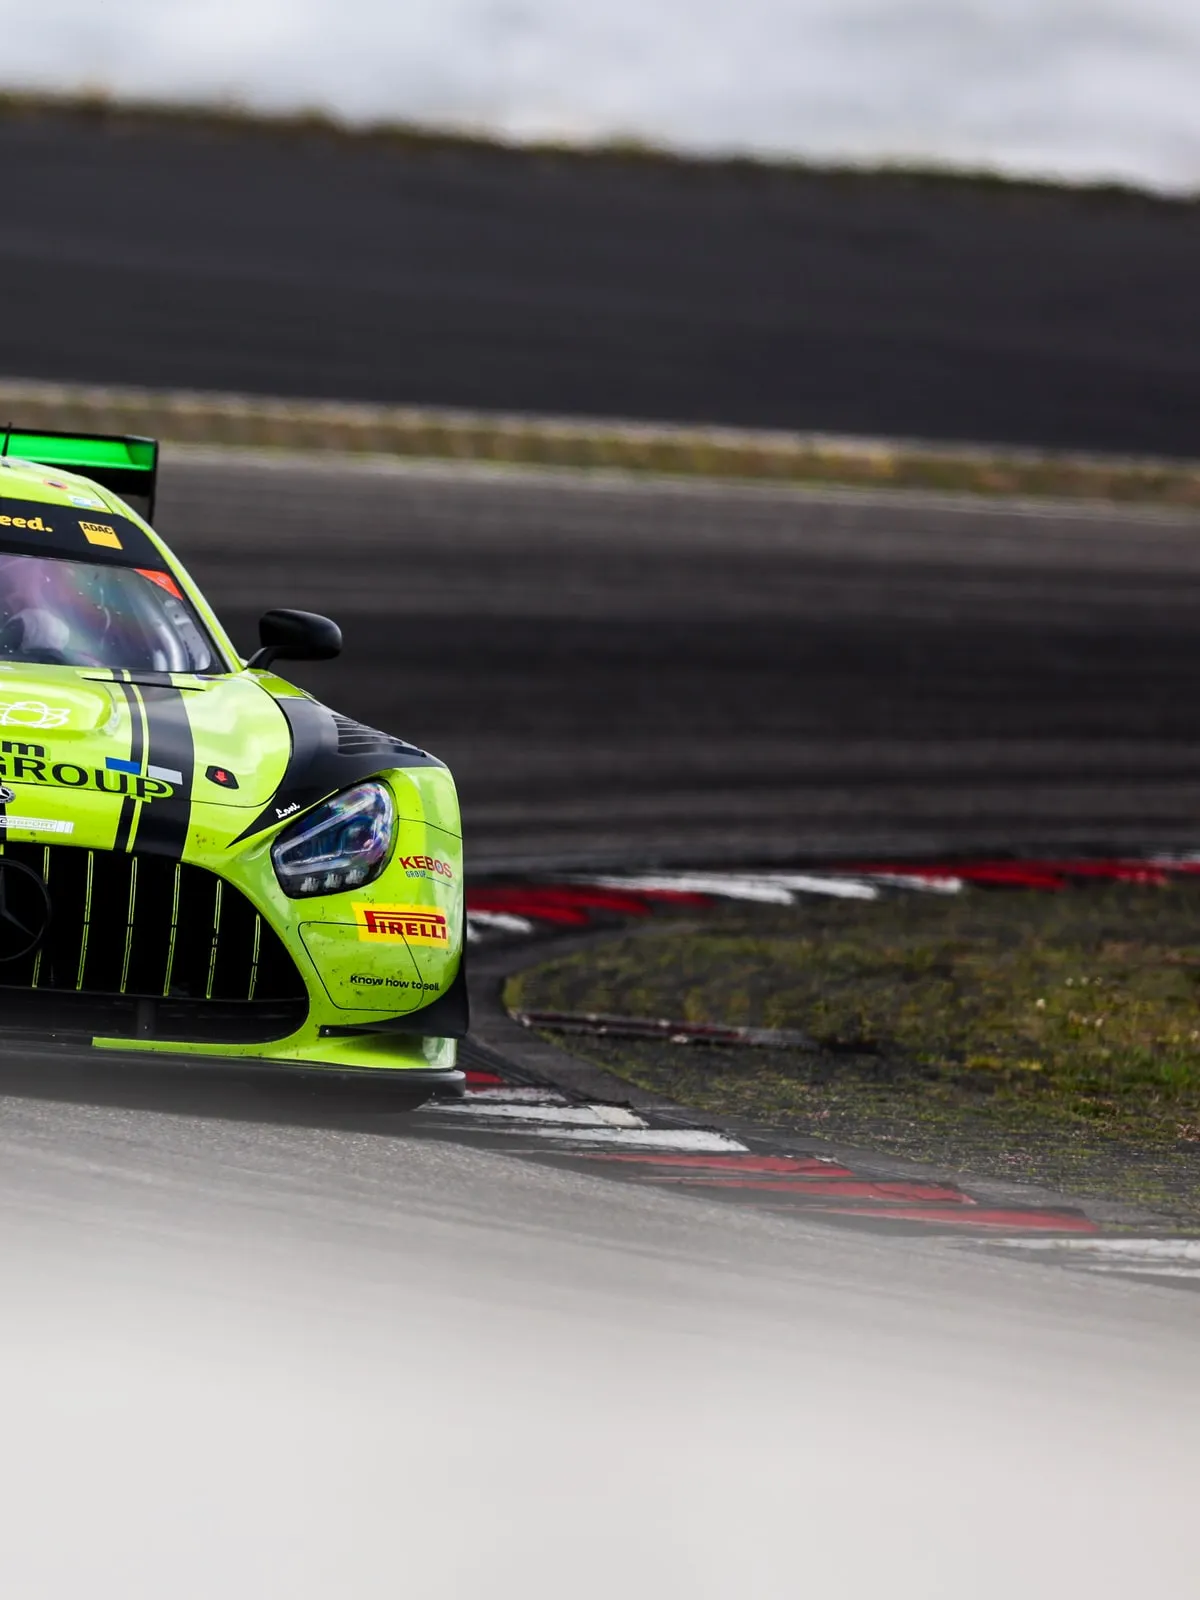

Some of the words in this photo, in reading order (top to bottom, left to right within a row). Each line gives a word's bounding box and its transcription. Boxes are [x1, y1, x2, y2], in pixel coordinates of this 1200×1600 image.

[82, 523, 113, 535] ADAC
[398, 855, 452, 878] KEBOS
[363, 910, 447, 940] PIRELLI
[350, 975, 384, 986] Know
[385, 977, 409, 988] how
[412, 981, 423, 991] to
[423, 982, 440, 991] sell
